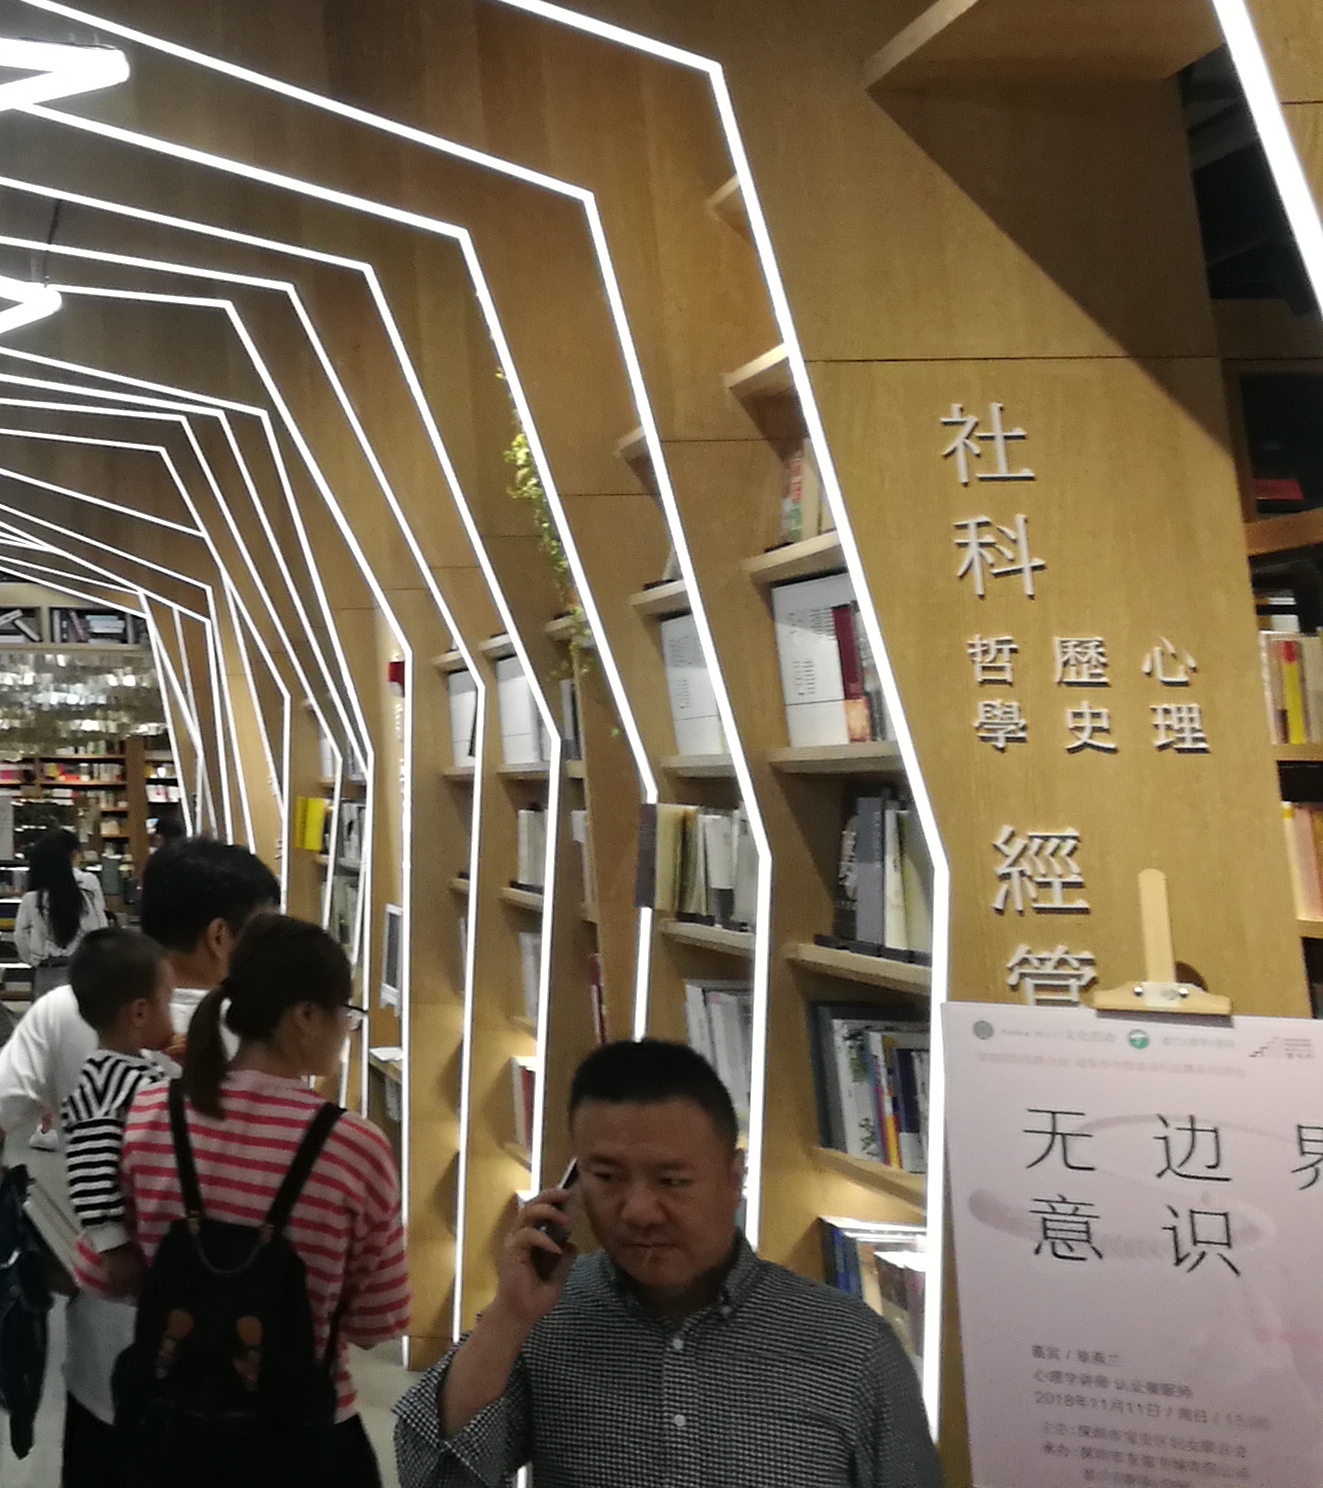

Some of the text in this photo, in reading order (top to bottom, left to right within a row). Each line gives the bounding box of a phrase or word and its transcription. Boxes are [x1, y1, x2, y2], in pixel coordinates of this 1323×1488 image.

[940, 403, 1047, 599] 社科
[967, 634, 1029, 751] 哲學
[1054, 636, 1118, 754] 歷史
[1141, 636, 1210, 754] 心理
[991, 825, 1098, 1007] 經管
[1028, 1194, 1241, 1277] 意识
